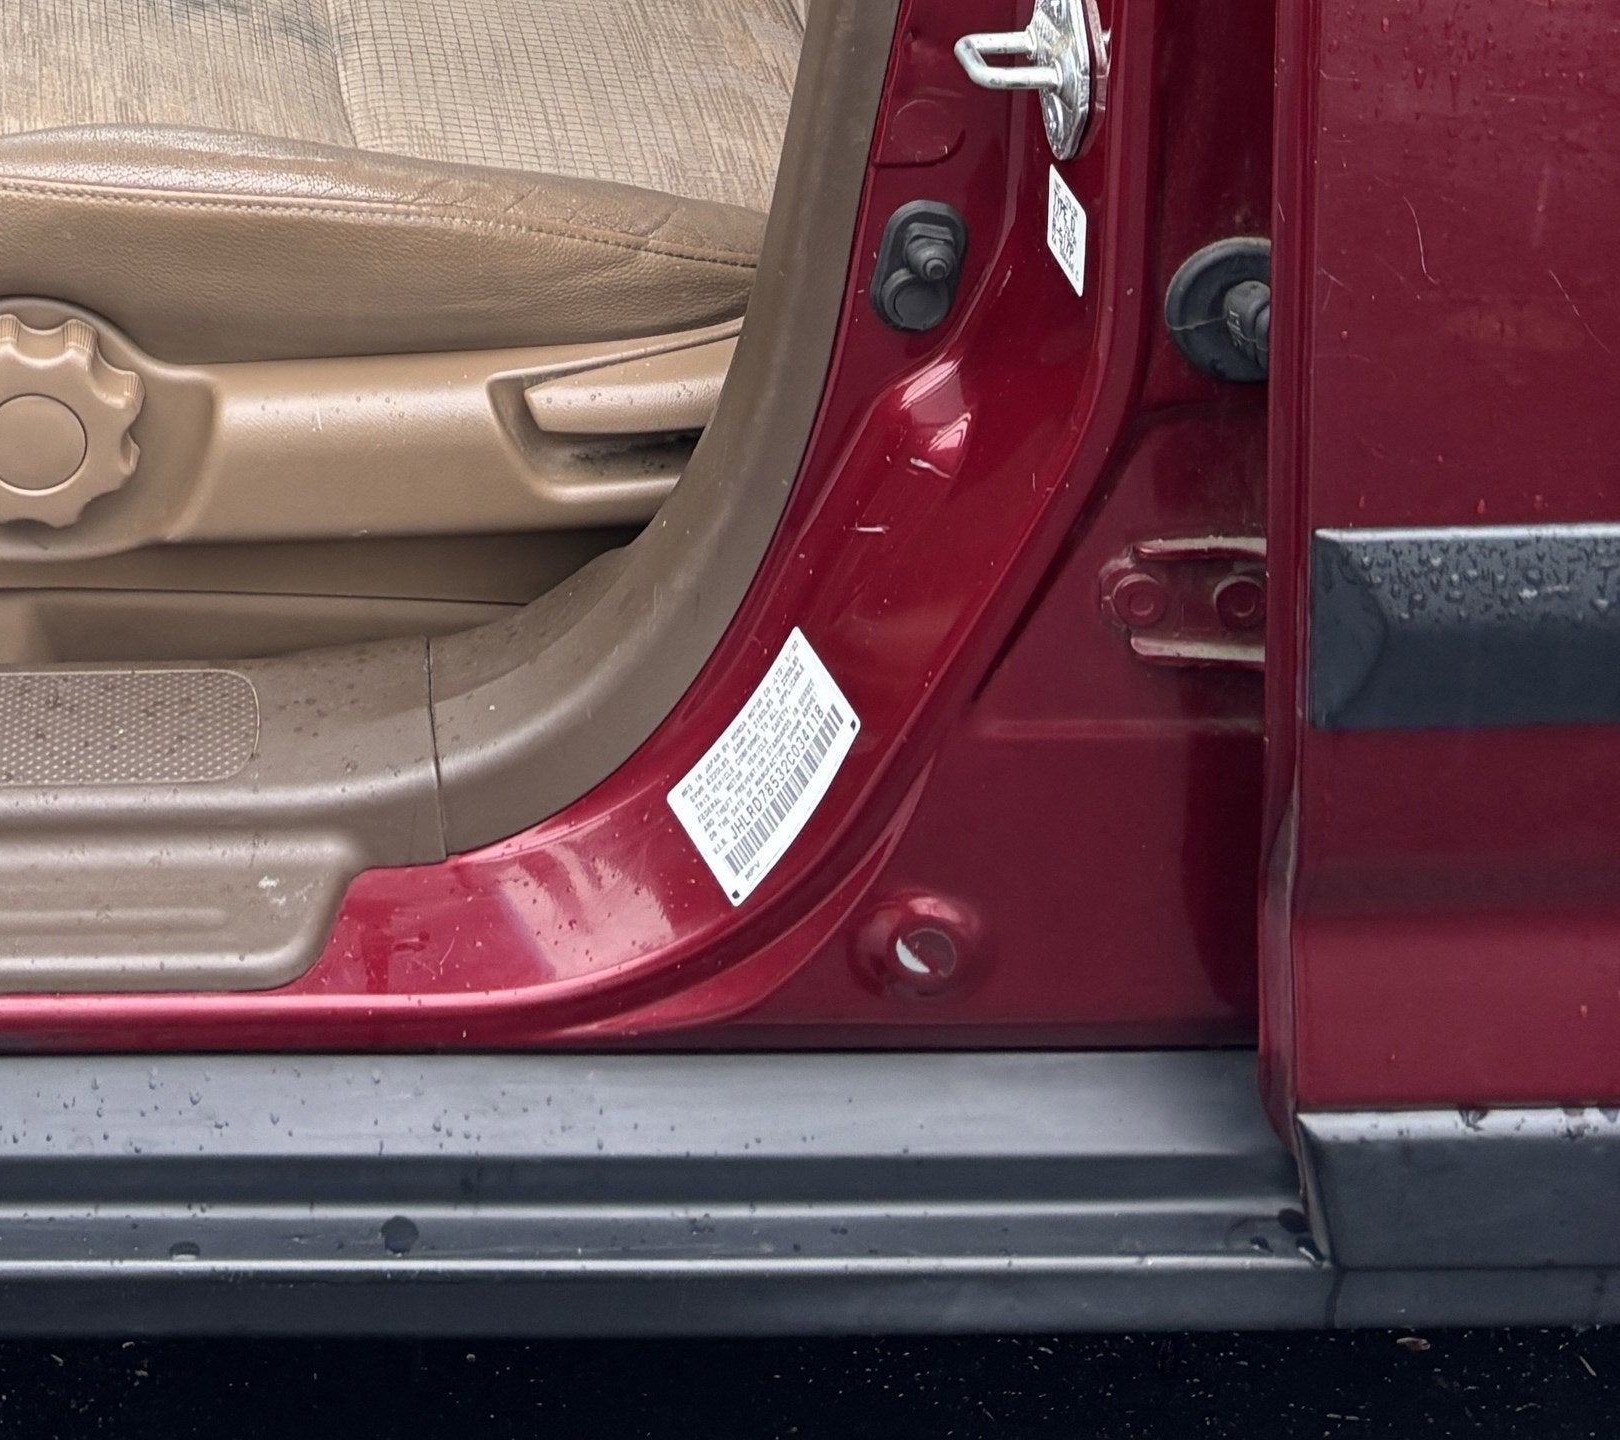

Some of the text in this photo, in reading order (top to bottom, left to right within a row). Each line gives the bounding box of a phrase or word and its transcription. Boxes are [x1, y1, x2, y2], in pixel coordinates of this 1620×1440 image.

[694, 662, 804, 811] THIS VEHICLE CONFORMS TO ALL APPLICABLE
[696, 795, 722, 823] FEDERAL
[725, 769, 743, 792] MOTOR
[746, 736, 768, 766] VEHICLE
[702, 677, 815, 832] AND THEFT PREVENTION STANDARDS IN EFFECT
[703, 751, 721, 774] JAPAN
[721, 741, 730, 753] BY
[730, 719, 747, 742] HONDA
[746, 696, 763, 720] MOTOR
[717, 815, 729, 829] THE
[730, 796, 745, 817] DATE
[745, 786, 753, 798] OF
[754, 742, 787, 787] MANUFACTURE
[786, 717, 802, 742] SHOWN
[731, 703, 824, 839] JHLRD78532C034118
[746, 727, 752, 735] F
